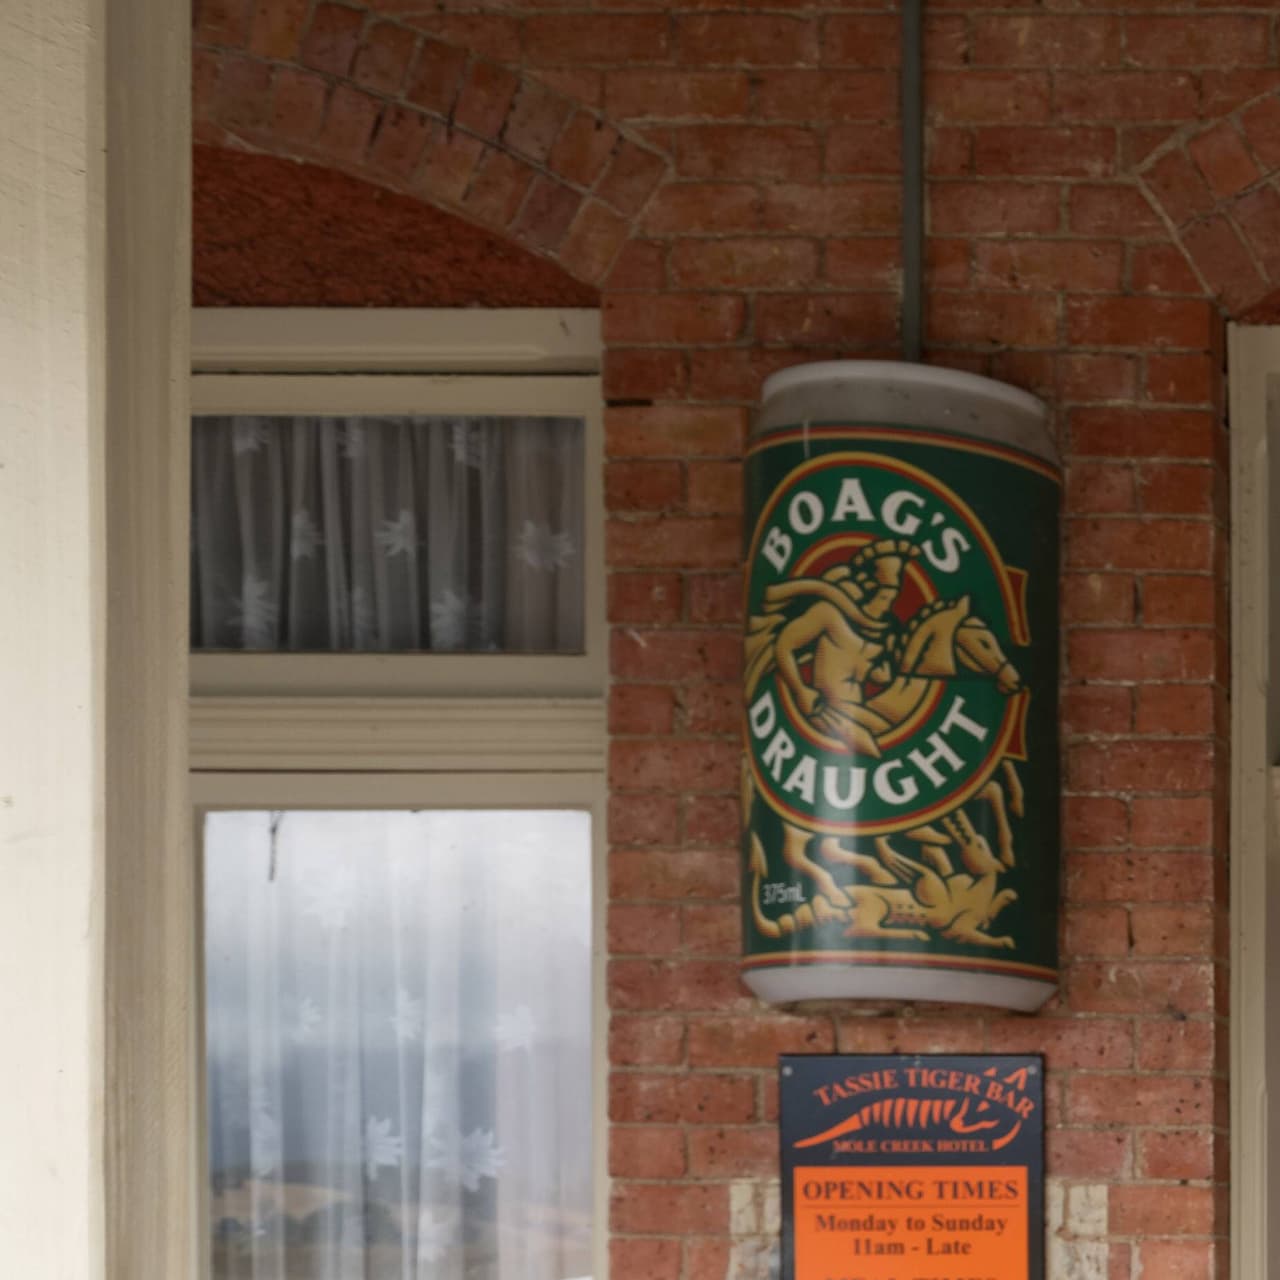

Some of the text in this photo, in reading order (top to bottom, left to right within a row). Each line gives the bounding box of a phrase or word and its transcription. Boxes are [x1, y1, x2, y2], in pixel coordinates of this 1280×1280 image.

[761, 477, 972, 574] BOAG'S
[748, 693, 987, 809] DRAUGHT
[814, 1067, 1035, 1119] TASSIE TIGER BAR
[833, 1140, 989, 1152] MOLE CREEK HOTEL
[803, 1180, 1019, 1200] OPENING TIMES
[816, 1214, 1007, 1236] Monday to Sunday
[854, 1239, 905, 1255] 11am
[926, 1239, 971, 1255] Late
